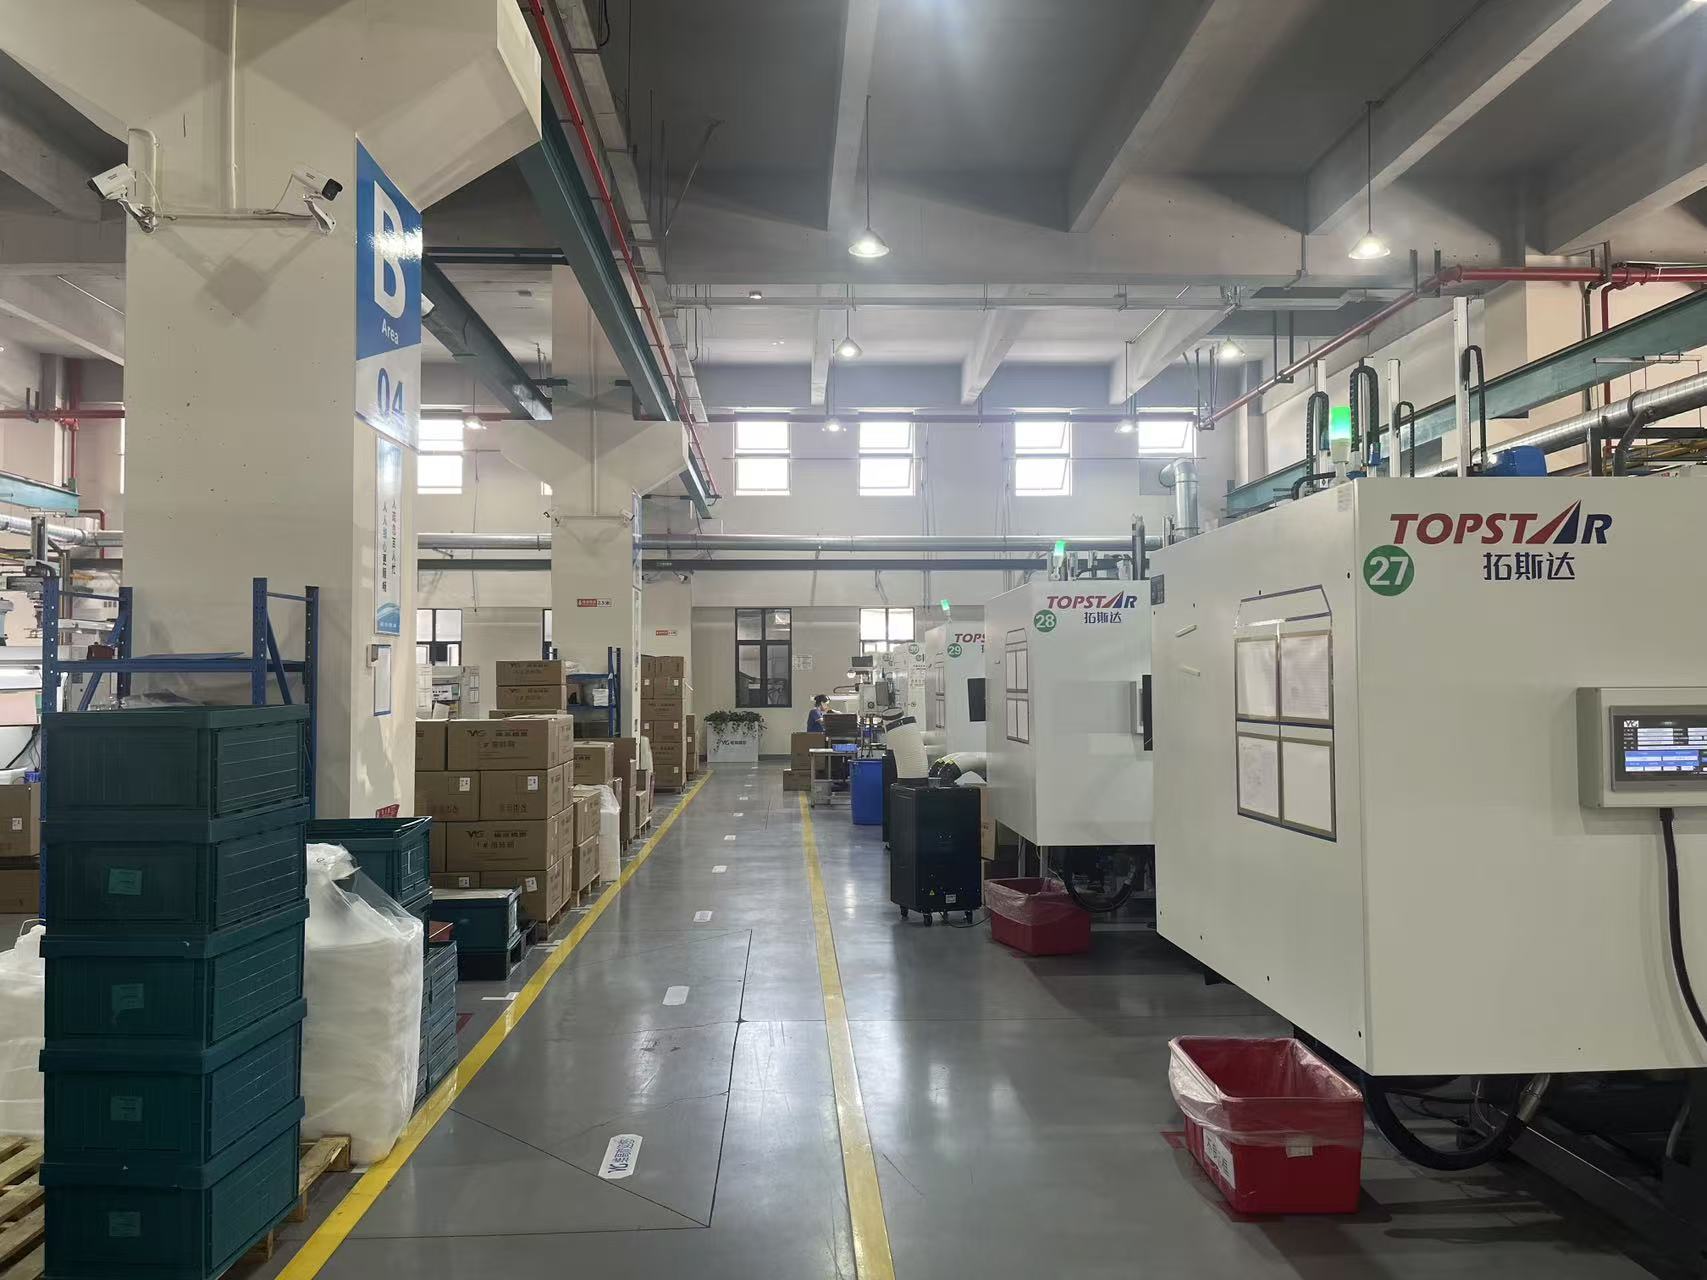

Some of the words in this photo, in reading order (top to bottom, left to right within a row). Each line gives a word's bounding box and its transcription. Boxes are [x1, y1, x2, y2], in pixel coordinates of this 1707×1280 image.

[374, 180, 406, 318] B
[381, 318, 400, 345] Area
[376, 367, 406, 419] 04
[1390, 499, 1612, 545] TOPSTAR
[1369, 556, 1409, 585] 27
[1482, 551, 1575, 580] 拓斯达
[1047, 590, 1138, 609] TOPSTAR
[1035, 614, 1055, 628] 28
[1083, 611, 1122, 624] 拓斯达
[948, 645, 961, 656] 29
